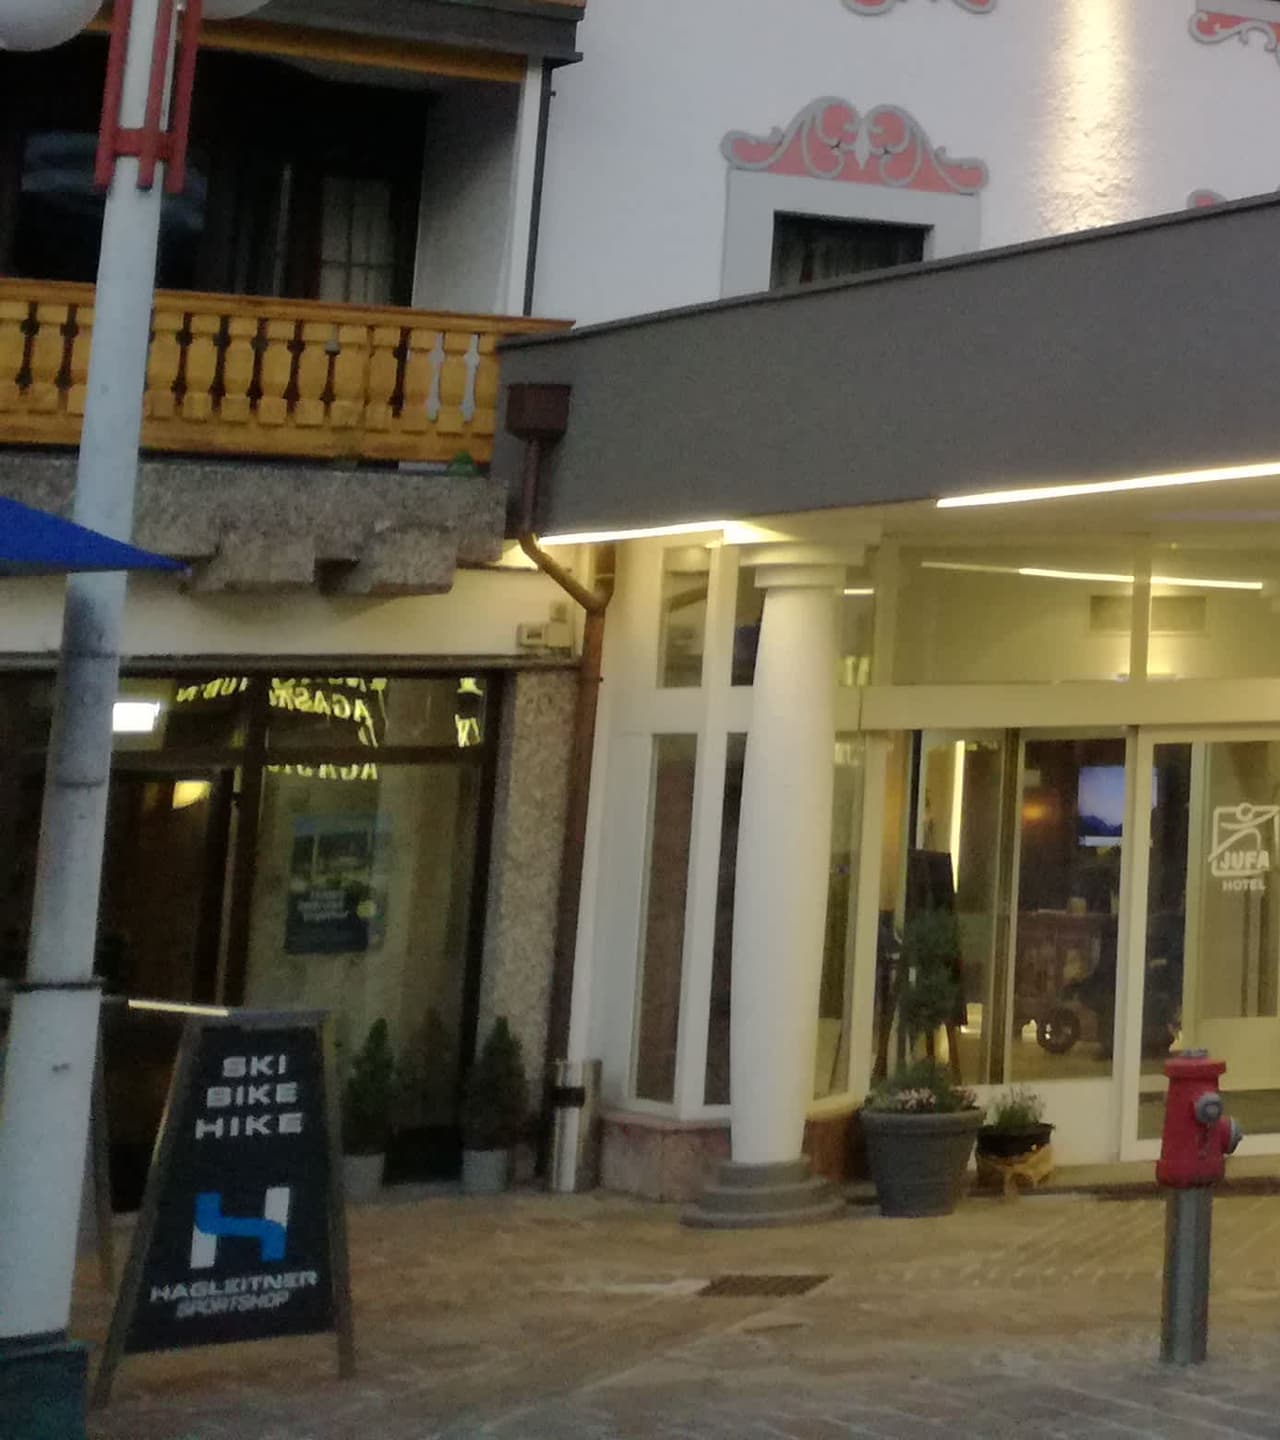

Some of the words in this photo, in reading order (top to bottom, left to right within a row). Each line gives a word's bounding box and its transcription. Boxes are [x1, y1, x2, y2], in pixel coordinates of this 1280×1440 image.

[1220, 850, 1270, 870] JUFA
[1222, 878, 1266, 891] HOTEL
[222, 1054, 287, 1078] SKI
[206, 1082, 298, 1109] BIKE
[195, 1112, 303, 1140] HIKE
